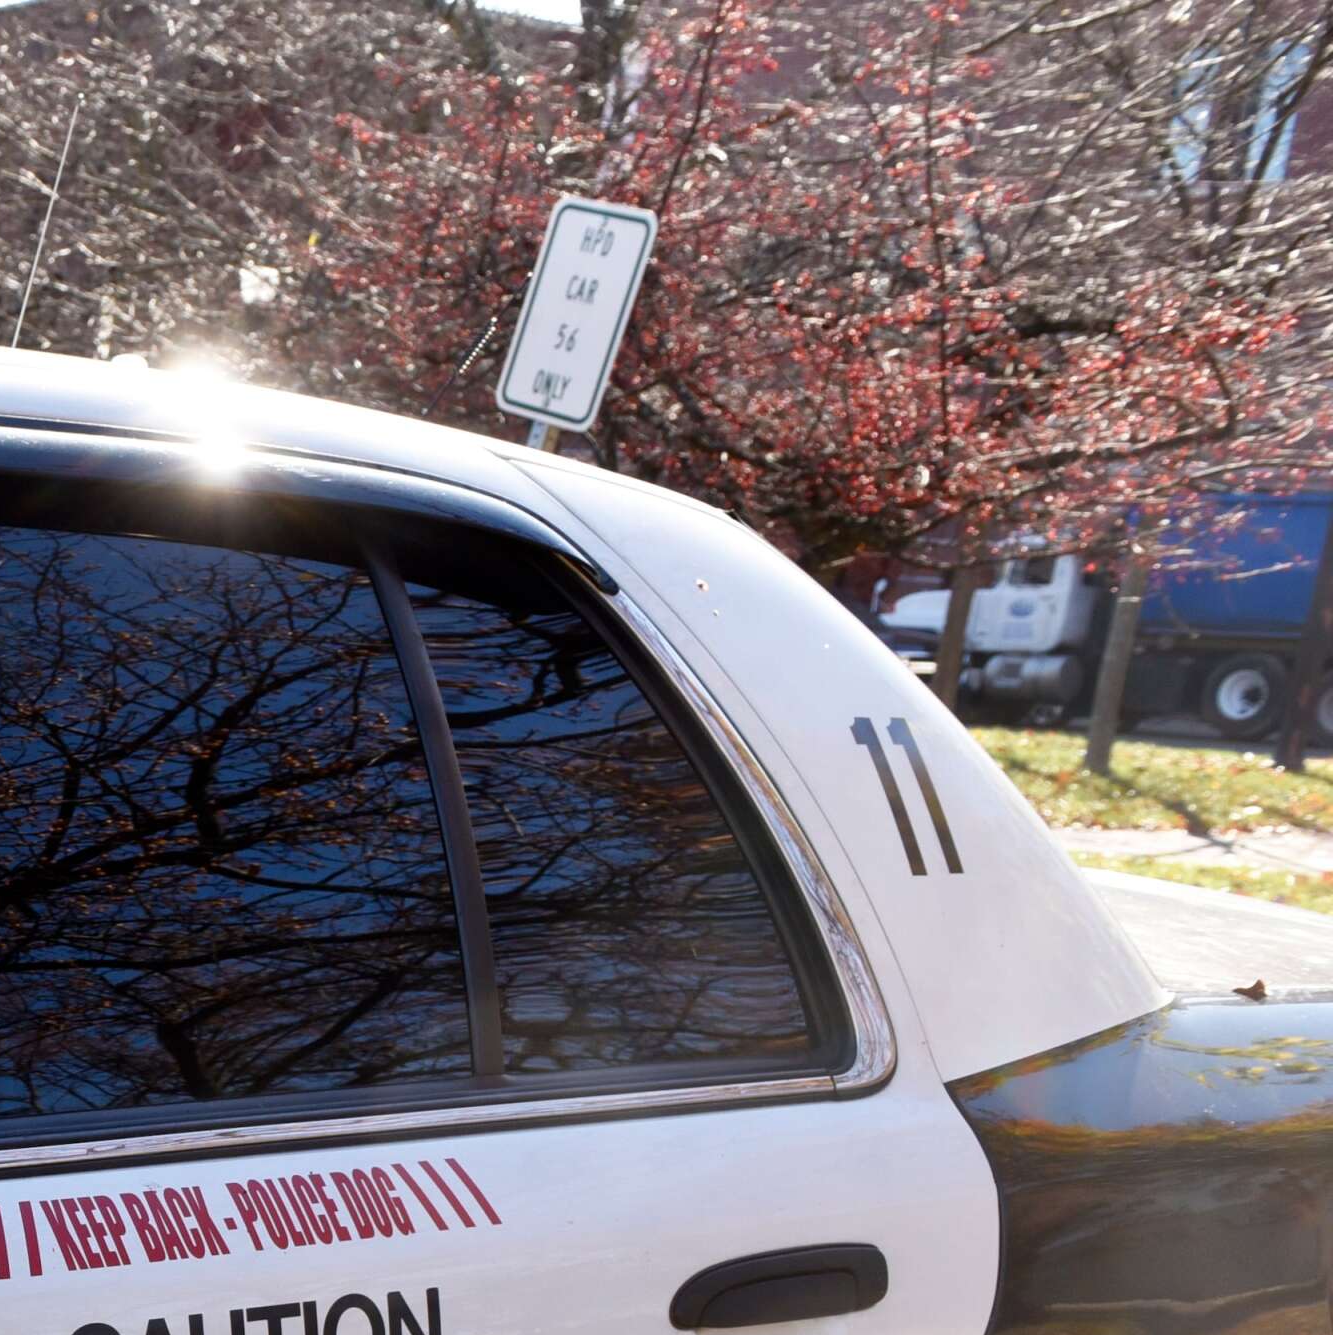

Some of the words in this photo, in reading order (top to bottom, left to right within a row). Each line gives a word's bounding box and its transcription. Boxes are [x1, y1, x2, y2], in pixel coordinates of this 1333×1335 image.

[579, 226, 615, 257] HPD
[565, 274, 599, 304] CAR
[553, 323, 580, 352] 56
[532, 368, 572, 401] ONLY
[849, 716, 965, 876] 11
[39, 1194, 132, 1272] KEEP
[120, 1186, 231, 1264] BACK
[225, 1171, 352, 1252] POLICE
[329, 1166, 416, 1241] DOG
